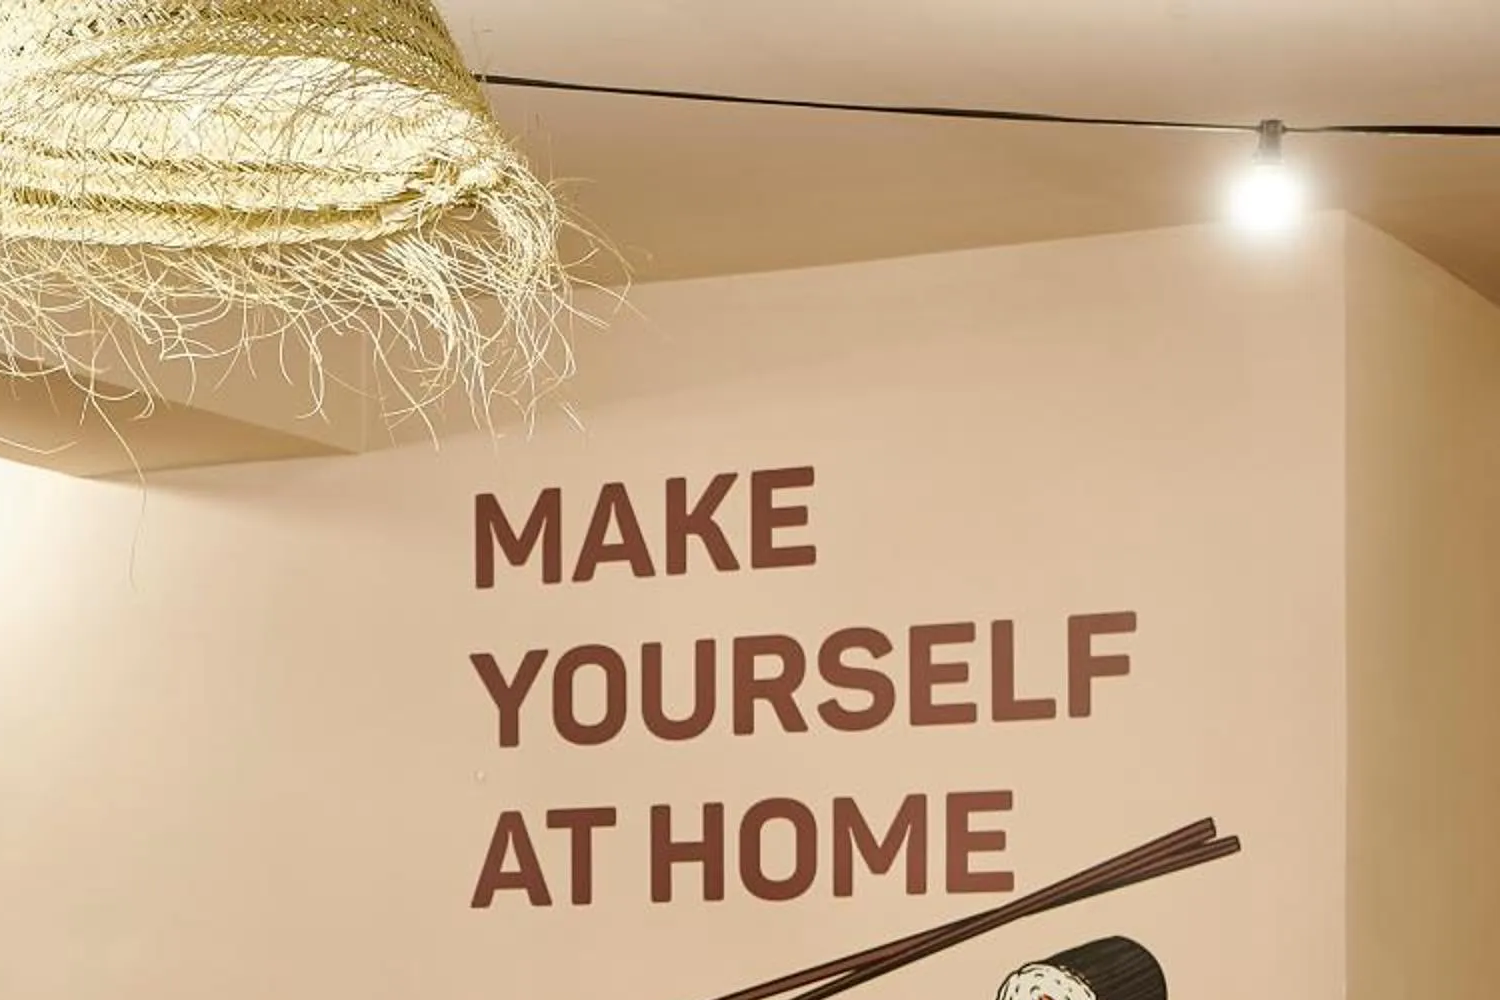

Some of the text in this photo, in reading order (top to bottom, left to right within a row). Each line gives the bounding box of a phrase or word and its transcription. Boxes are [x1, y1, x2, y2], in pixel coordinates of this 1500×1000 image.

[475, 465, 817, 590] MAKE
[469, 611, 1137, 748] YOURSELF
[470, 789, 1015, 909] AT HOME
